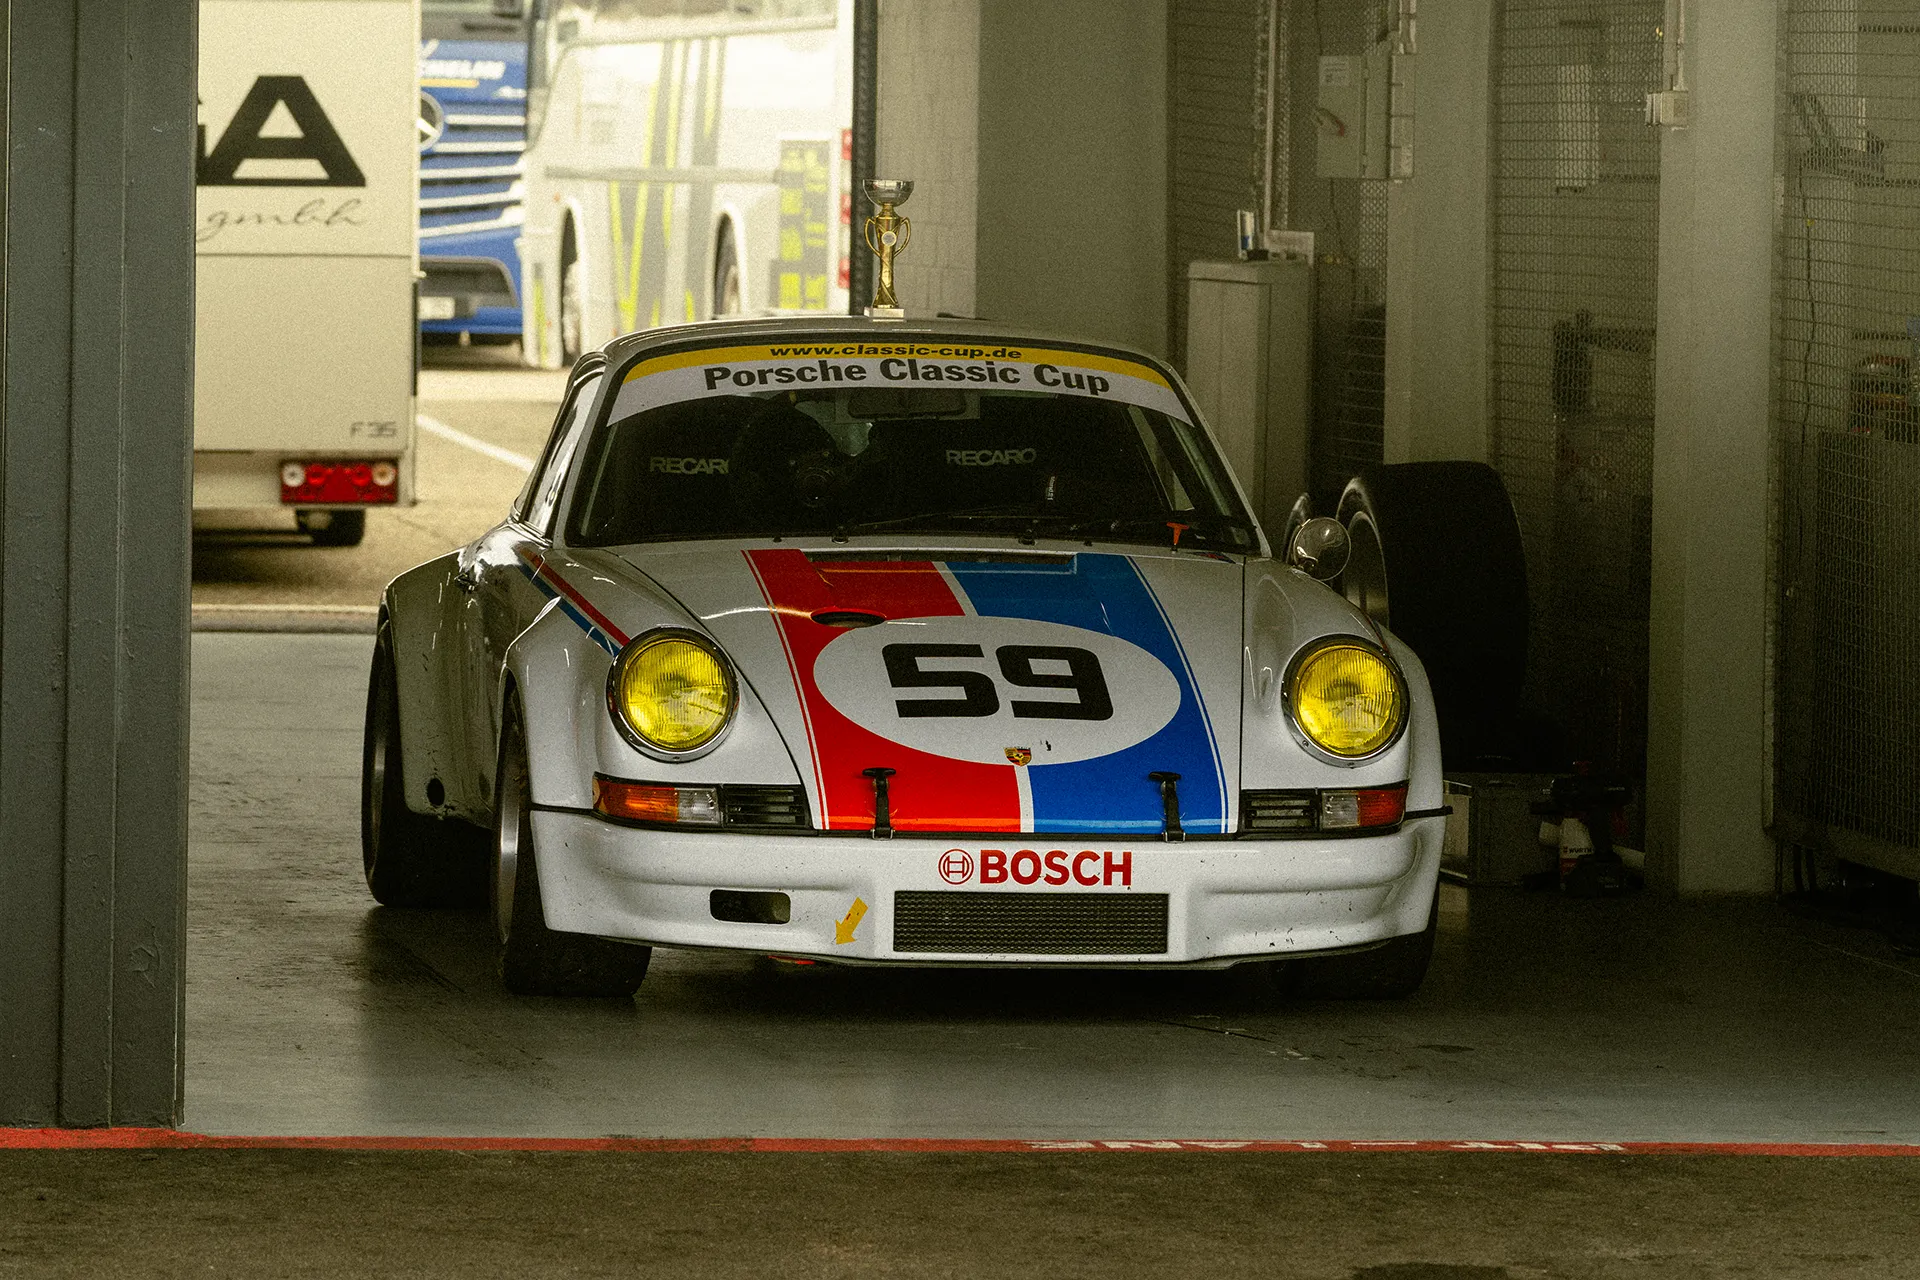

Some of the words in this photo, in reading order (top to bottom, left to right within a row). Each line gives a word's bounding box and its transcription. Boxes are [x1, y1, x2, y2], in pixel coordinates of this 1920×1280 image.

[197, 75, 366, 187] A
[770, 344, 1022, 359] www.classic-cup.de
[705, 359, 867, 390] Porsche
[880, 358, 1021, 384] Classic
[1033, 364, 1110, 395] Cup
[650, 456, 730, 475] RECAR
[945, 447, 1037, 467] RECARO
[882, 644, 1114, 720] 59
[980, 850, 1133, 886] BOSCH
